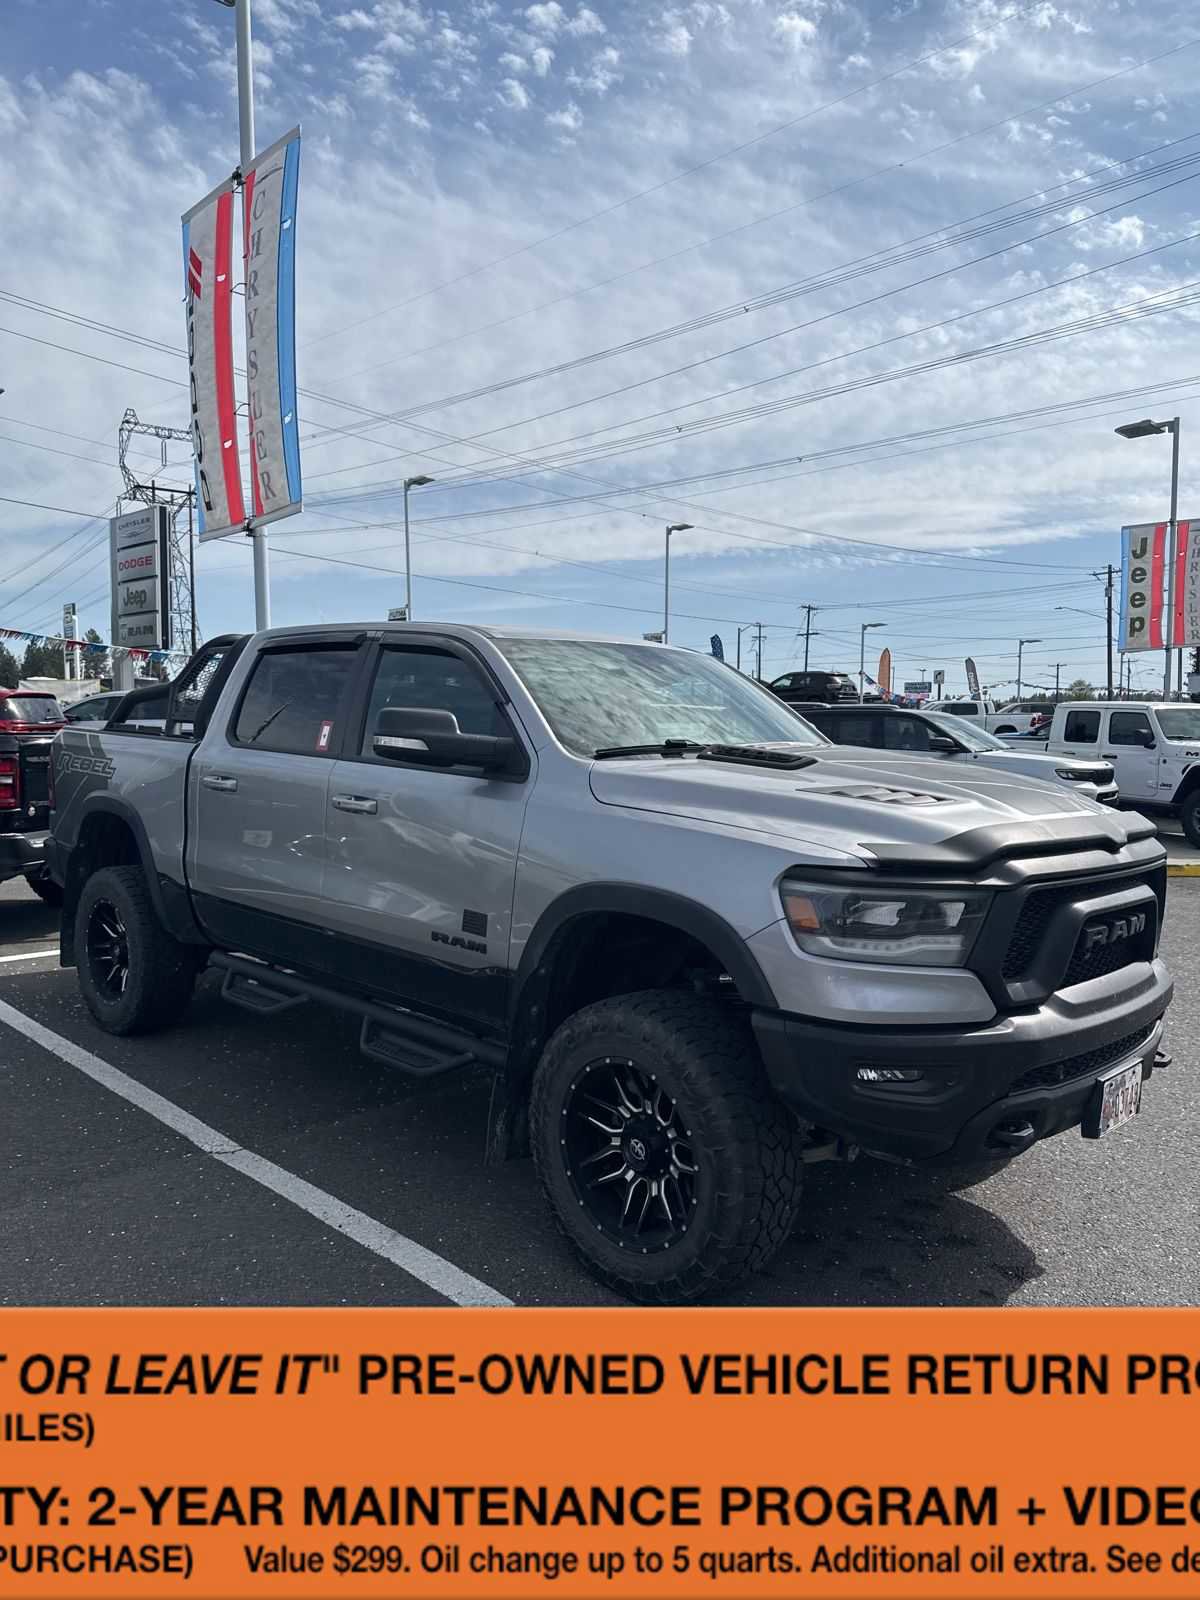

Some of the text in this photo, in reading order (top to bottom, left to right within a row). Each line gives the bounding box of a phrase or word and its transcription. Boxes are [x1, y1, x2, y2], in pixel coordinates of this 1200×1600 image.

[118, 555, 153, 571] DODGE
[123, 587, 147, 608] Jeep
[1129, 537, 1148, 637] Jeep
[128, 624, 154, 637] RAM
[1085, 913, 1146, 948] RAM
[431, 930, 487, 955] RAM
